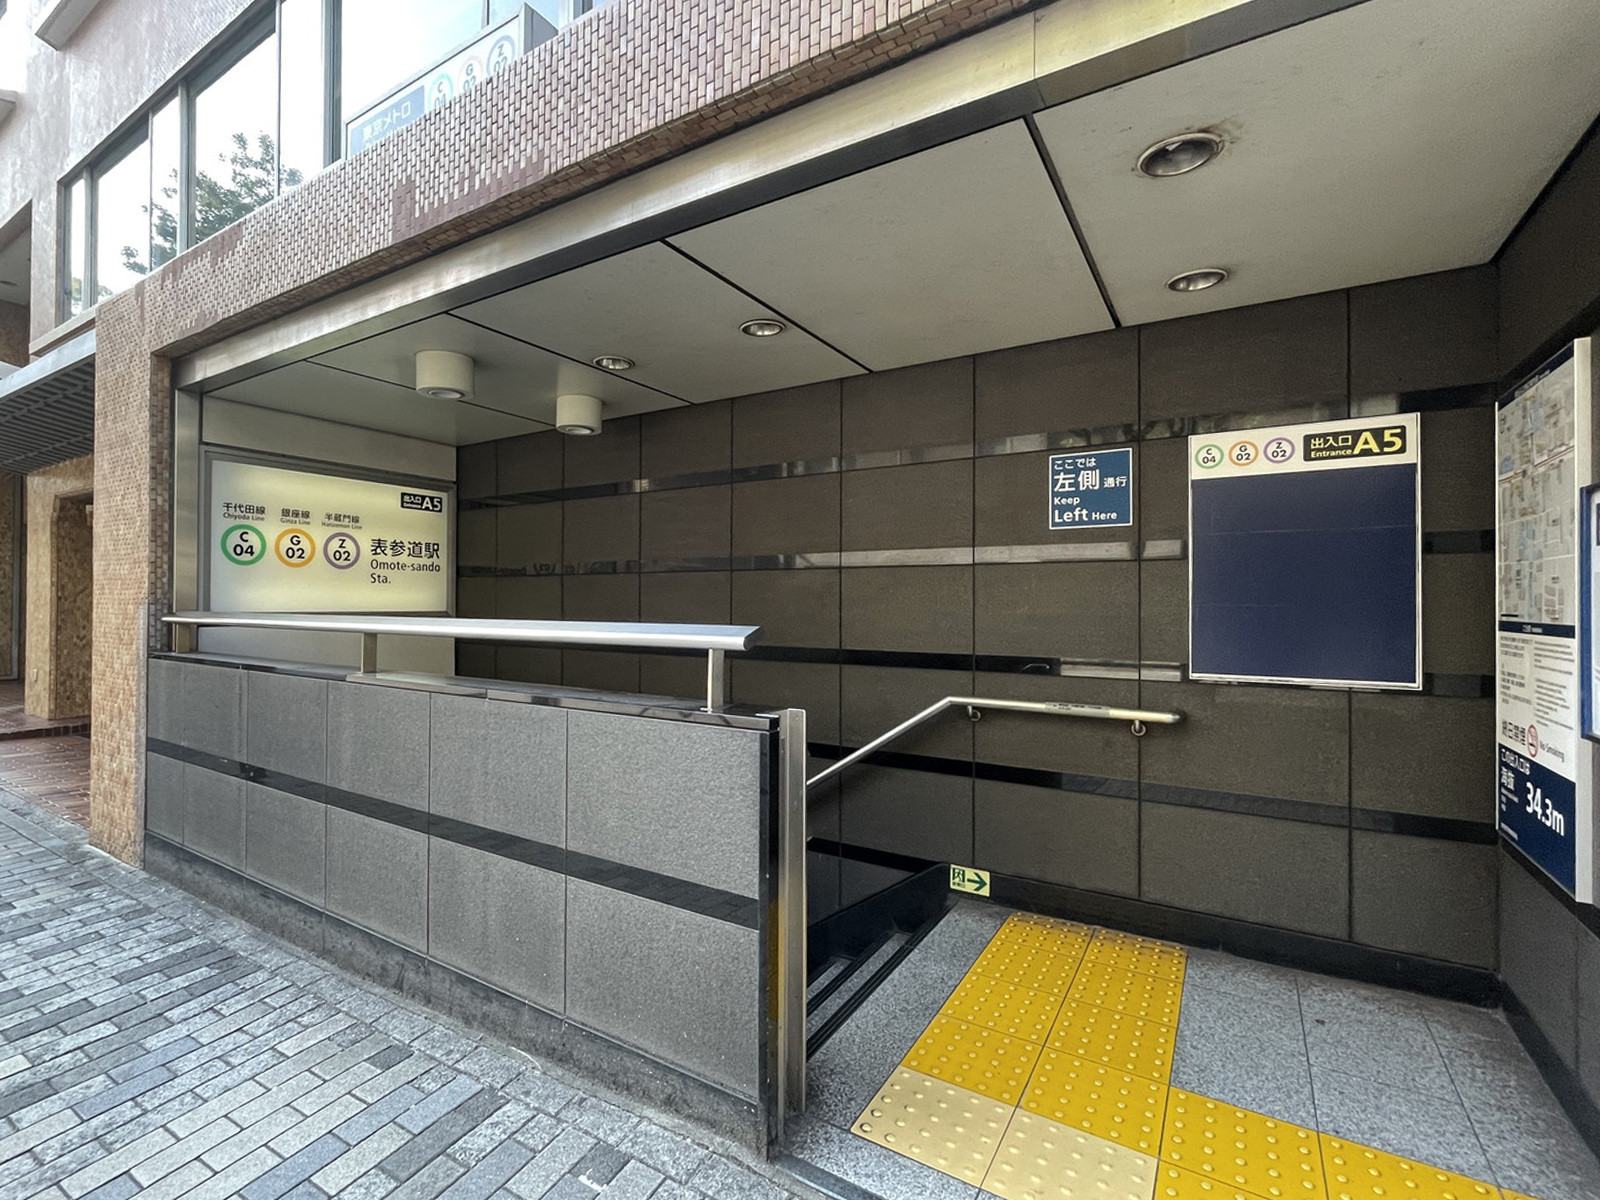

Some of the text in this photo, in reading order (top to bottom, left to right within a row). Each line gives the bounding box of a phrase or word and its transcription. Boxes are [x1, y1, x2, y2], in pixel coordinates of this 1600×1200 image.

[1310, 435, 1352, 449] 出入口
[1353, 428, 1402, 454] A5
[1206, 448, 1212, 456] C
[1240, 444, 1247, 452] G
[1310, 448, 1352, 458] Entrance
[1236, 452, 1251, 461] 02
[1272, 450, 1287, 458] 02
[1054, 458, 1096, 470] ここでは
[1202, 456, 1216, 464] 04
[1054, 469, 1100, 492] 左側
[422, 496, 441, 511] A5
[1054, 496, 1080, 506] Keep
[222, 502, 266, 515] 千代田線
[281, 508, 310, 519] 銀座線
[222, 512, 250, 520] Chiyoda
[1054, 508, 1118, 522] Left Here
[240, 532, 249, 542] C
[290, 535, 301, 546] G
[338, 538, 346, 549] Z
[370, 538, 440, 560] 表参道駅
[233, 544, 255, 557] 04
[285, 546, 305, 560] 02
[333, 550, 350, 562] 02
[370, 558, 440, 572] Omote-sando
[370, 573, 392, 584] Sta.
[1526, 781, 1565, 836] 34.3m
